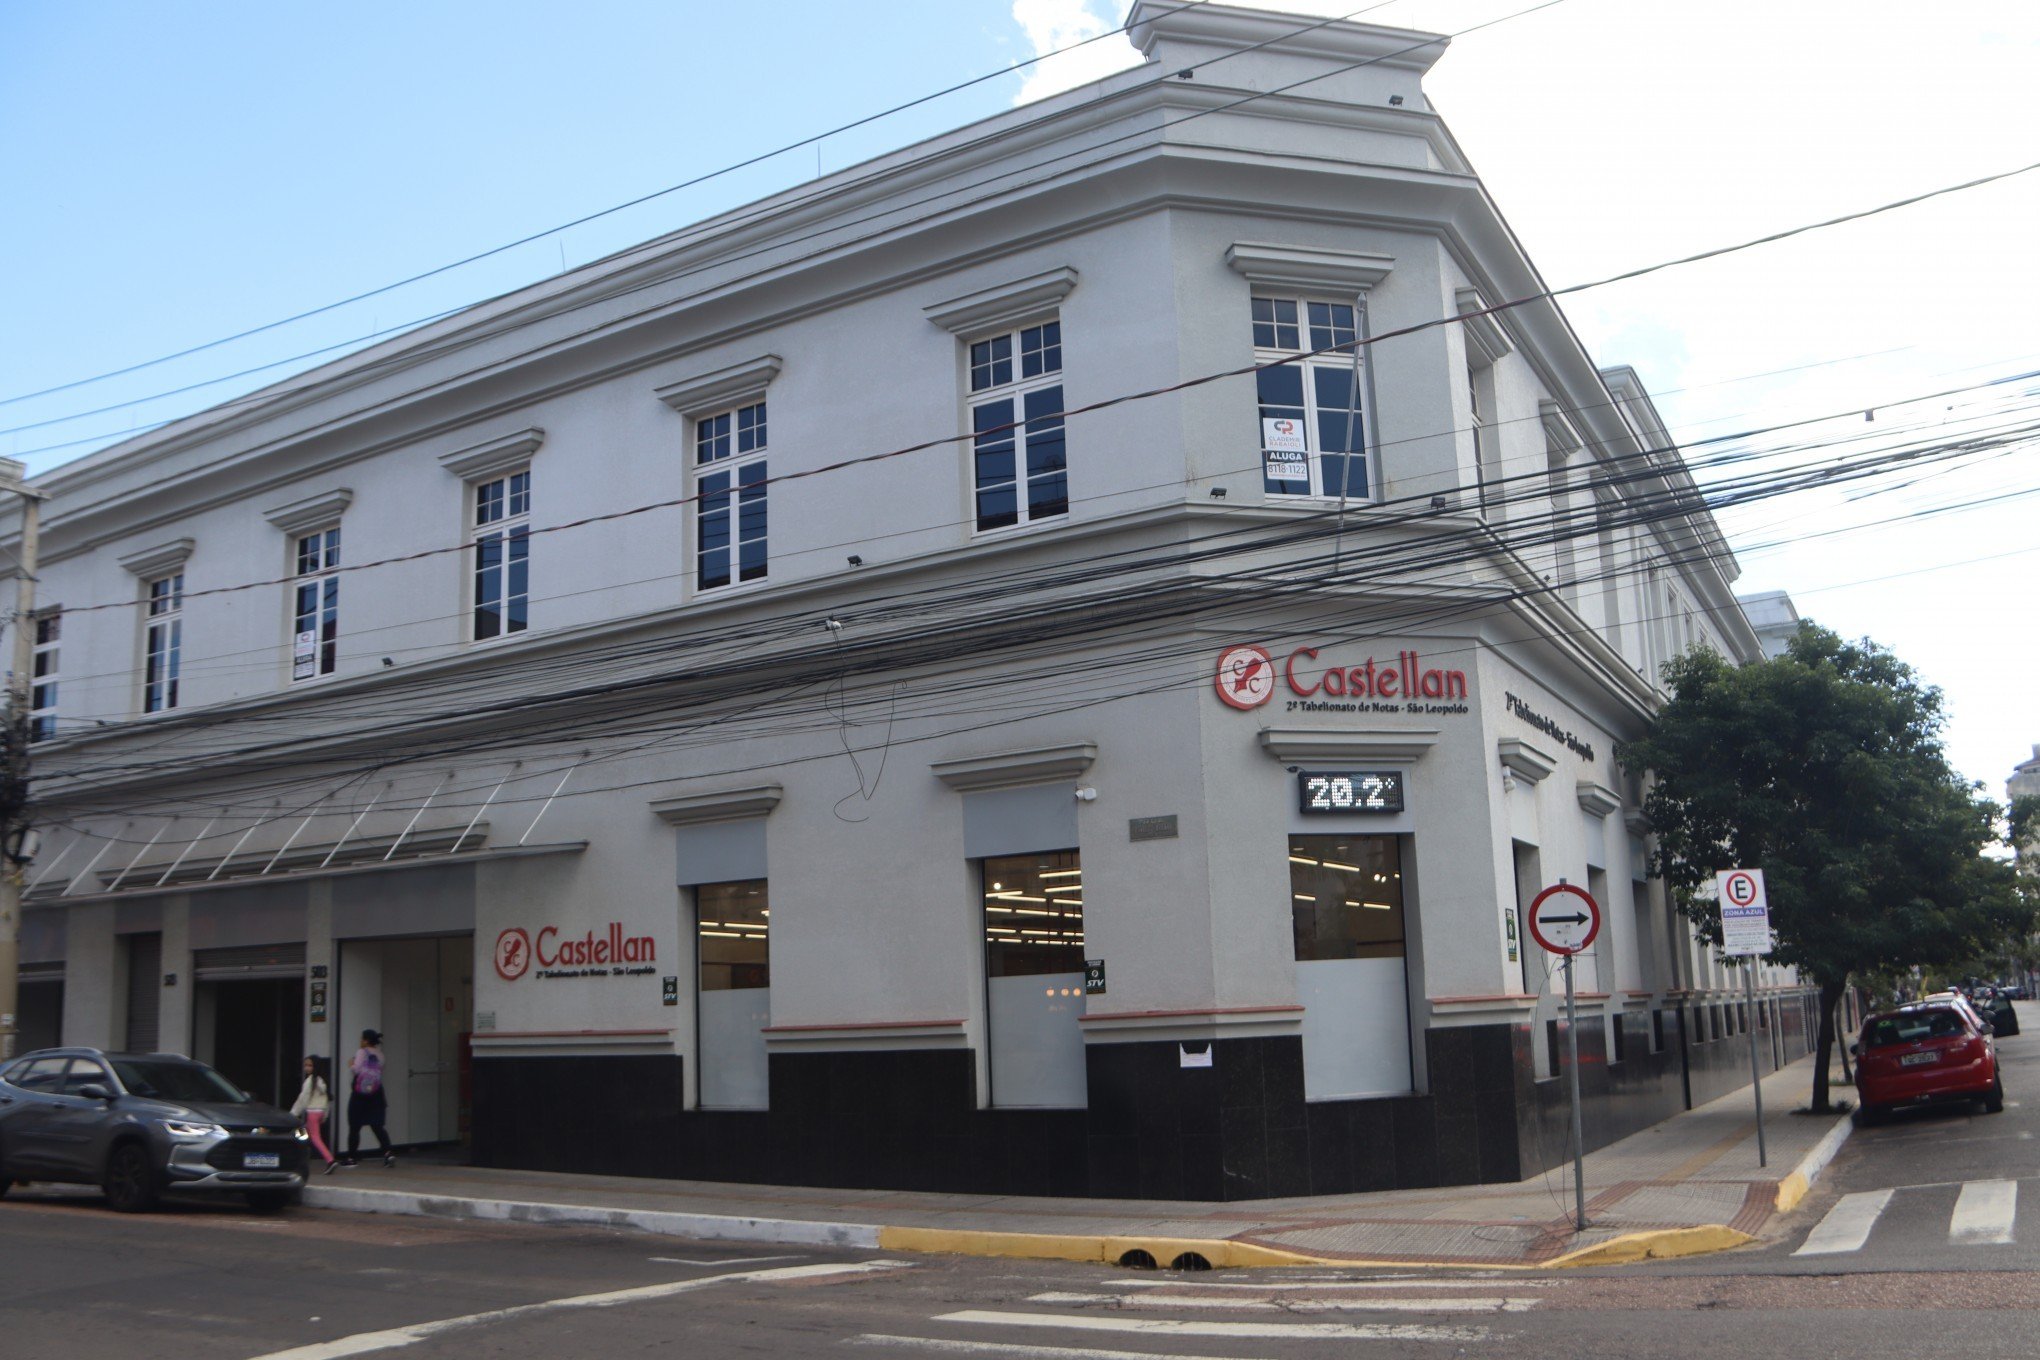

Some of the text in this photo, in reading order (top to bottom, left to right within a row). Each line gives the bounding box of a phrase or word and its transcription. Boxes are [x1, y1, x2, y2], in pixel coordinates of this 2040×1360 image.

[1270, 452, 1302, 460] ALUGA
[1286, 647, 1468, 698] Castellan
[1300, 701, 1356, 713] Tabelionato
[1358, 702, 1371, 712] de
[1372, 702, 1399, 713] Notas
[1407, 703, 1424, 713] São
[1425, 703, 1468, 716] Leopoldo
[1734, 880, 1748, 899] E
[536, 922, 656, 967] Castellan
[1087, 979, 1104, 987] STV
